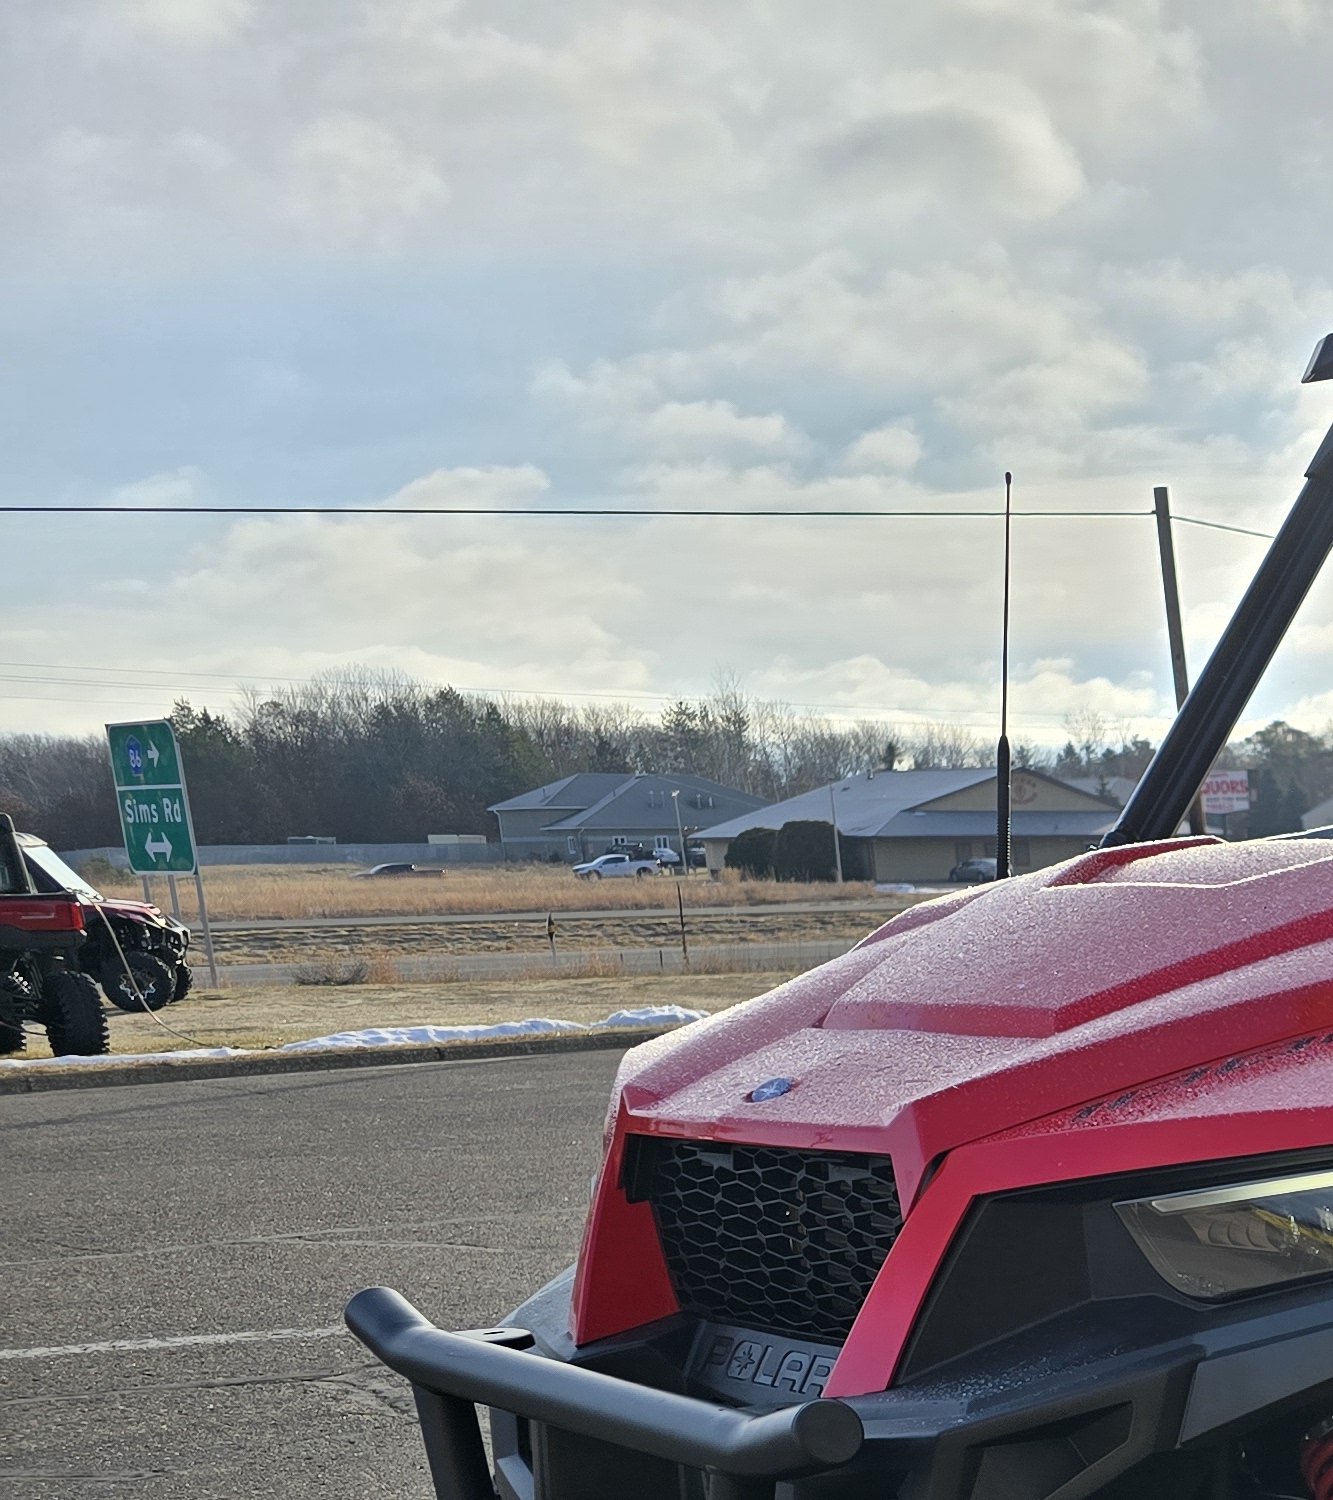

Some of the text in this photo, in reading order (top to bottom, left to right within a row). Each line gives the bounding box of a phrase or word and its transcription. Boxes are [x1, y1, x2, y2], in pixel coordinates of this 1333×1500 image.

[129, 749, 141, 768] 86
[1200, 779, 1249, 795] QUORS
[125, 797, 182, 824] Sims Rd
[703, 1335, 838, 1397] POLAR
